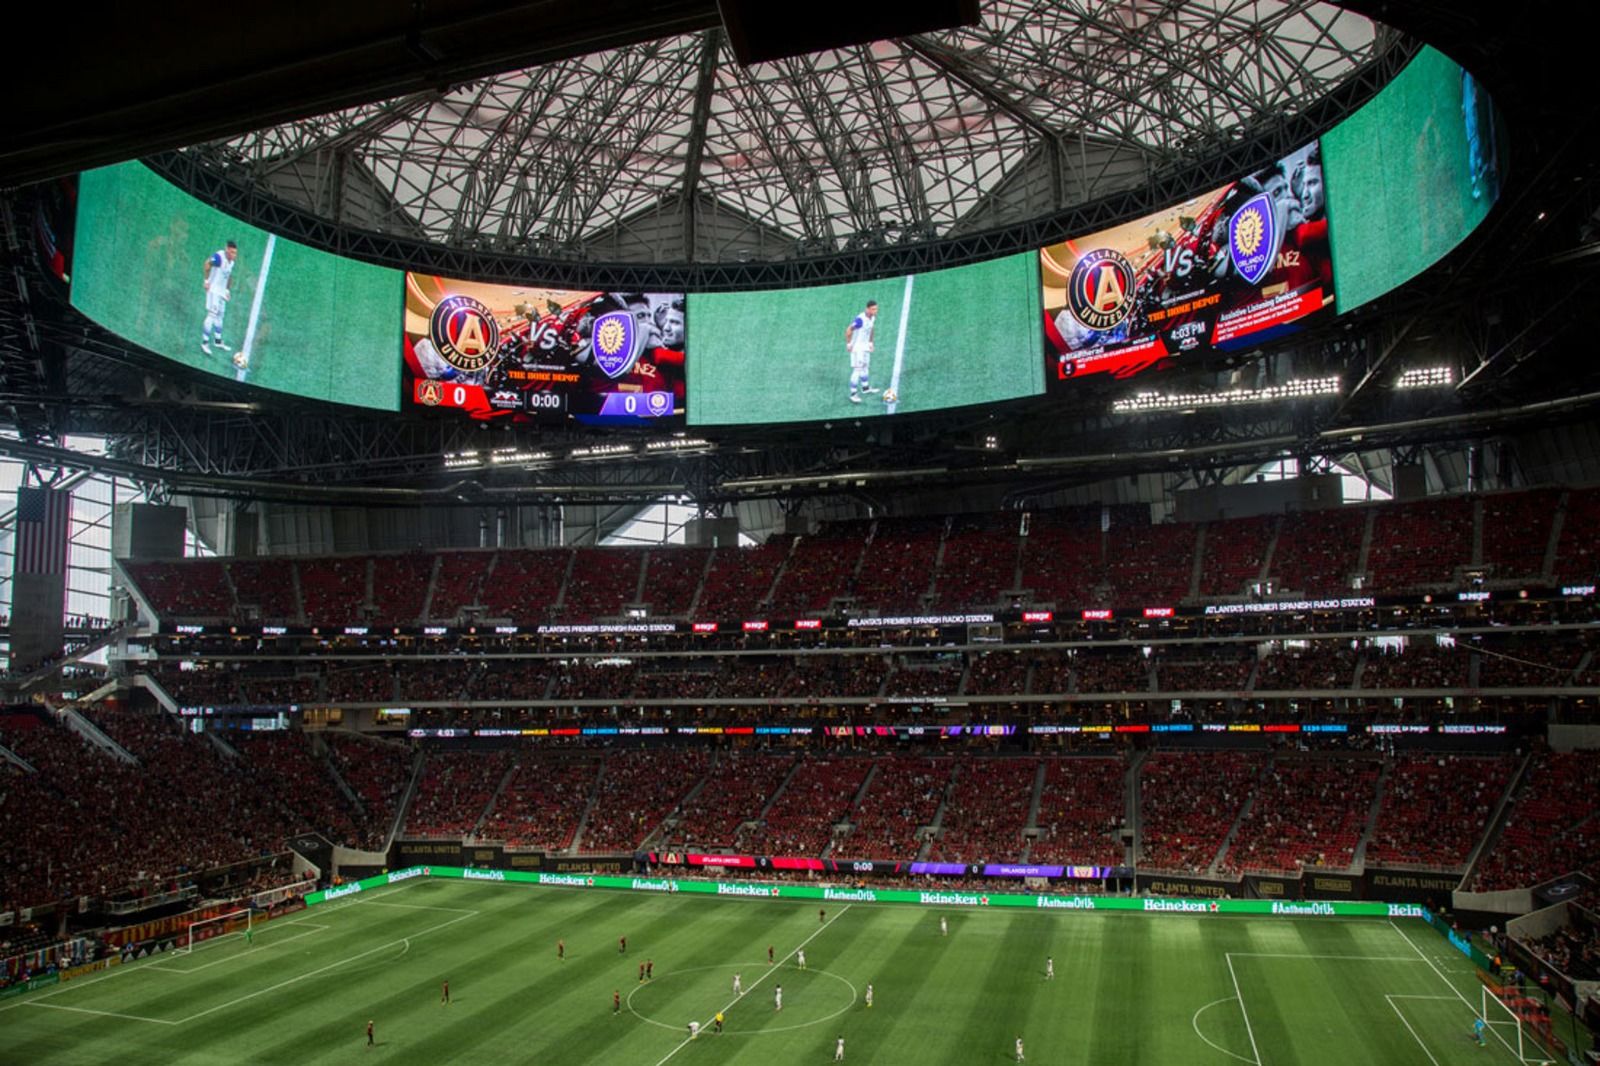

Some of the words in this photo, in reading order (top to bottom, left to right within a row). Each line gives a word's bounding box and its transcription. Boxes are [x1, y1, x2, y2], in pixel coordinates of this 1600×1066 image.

[1083, 250, 1127, 268] ATLANTA
[1165, 245, 1194, 278] VS
[1237, 254, 1265, 268] ORLANDO
[1245, 263, 1258, 273] CITY
[448, 298, 494, 321] ATLANTA
[1148, 310, 1166, 323] THE
[1192, 293, 1221, 311] DEPOT
[1081, 306, 1123, 326] UNITED
[1191, 321, 1206, 335] PM
[530, 321, 558, 350] VS
[441, 342, 484, 369] UNITED
[508, 370, 526, 379] THE
[552, 373, 580, 382] DEPOT
[454, 386, 466, 405] 0
[532, 393, 560, 408] 0:00
[625, 395, 637, 413] 0
[401, 844, 433, 853] ATLANTA
[434, 844, 461, 854] UNITED
[557, 862, 590, 872] ATLANTA
[592, 862, 621, 872] UNITED
[853, 862, 873, 872] 0:00
[539, 873, 586, 886] Heineken
[1374, 874, 1417, 888] ATLANTA
[718, 883, 769, 896] Heineken
[824, 889, 877, 902] #AnthemOfUs
[1151, 881, 1189, 895] ATLANTA
[1191, 886, 1226, 897] UNITED
[920, 892, 978, 905] Heineken
[1037, 895, 1095, 908] #AnthemOfUs
[1144, 899, 1207, 912] Heineken
[1271, 901, 1336, 915] #AnthemOfUs
[1388, 903, 1423, 917] Hein
